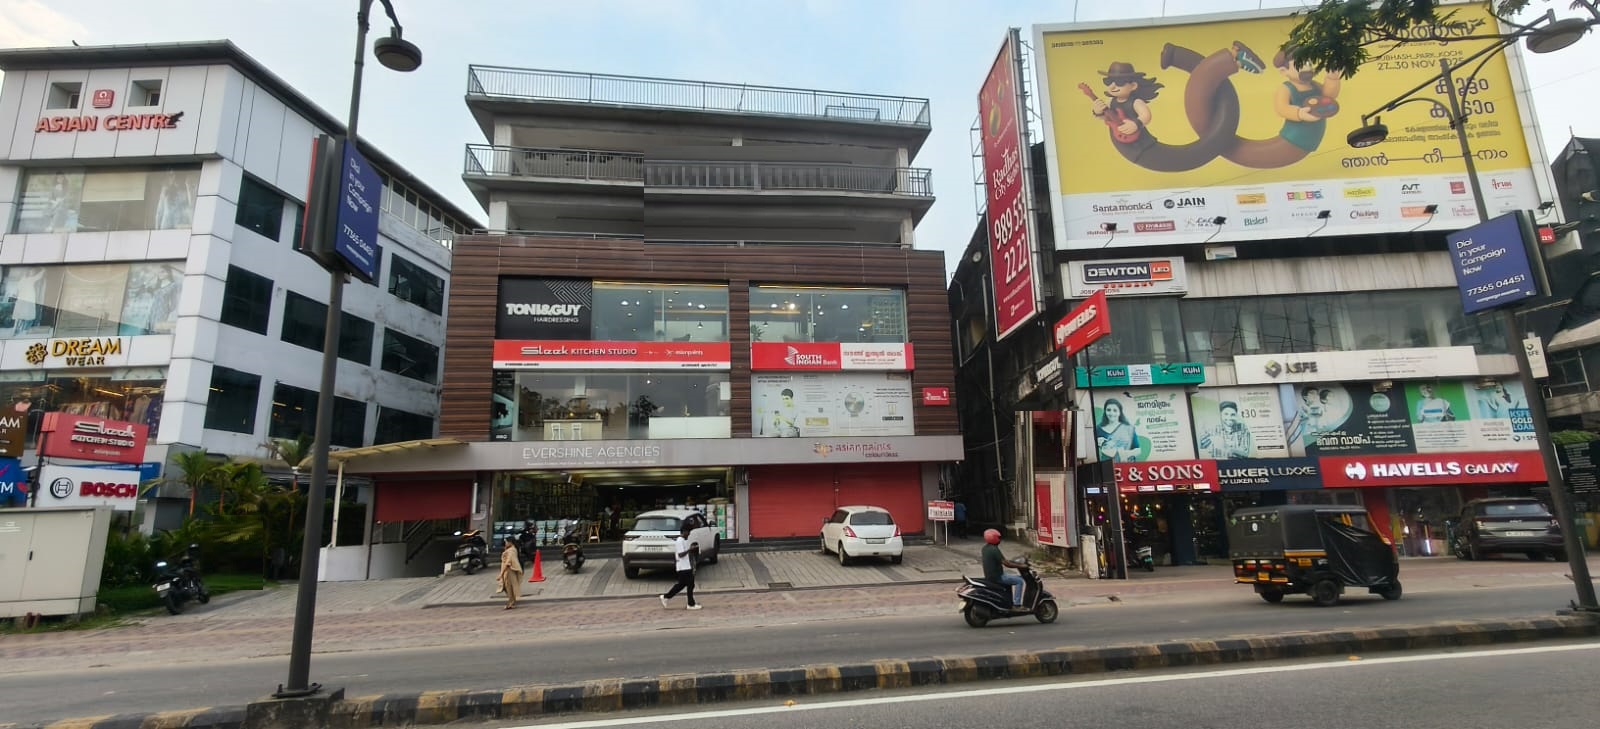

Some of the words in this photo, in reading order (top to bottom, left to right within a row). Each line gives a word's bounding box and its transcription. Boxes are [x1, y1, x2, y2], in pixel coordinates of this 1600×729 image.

[1411, 60, 1436, 69] NOV
[35, 116, 98, 133] ASIAN
[1177, 197, 1205, 207] JAIN
[994, 207, 1013, 250] 989
[1456, 237, 1473, 249] Dial
[1459, 250, 1467, 258] in
[1466, 244, 1486, 256] your
[1461, 247, 1506, 266] Campaign
[1087, 266, 1148, 277] DEWTON
[1462, 265, 1482, 275] Now
[1467, 283, 1494, 296] 77365
[1496, 274, 1525, 288] 04451
[506, 303, 582, 316] TONI&GUY
[52, 338, 121, 357] DREAM
[66, 356, 105, 366] WEAR
[522, 447, 593, 459] EVERSHINE
[597, 446, 660, 458] AGENCIES
[1128, 466, 1143, 482] &
[1148, 463, 1204, 480] SONS
[1218, 467, 1269, 478] LUKER
[1270, 465, 1317, 477] LUXXE
[1372, 462, 1461, 477] HAVELLS
[1464, 462, 1520, 475] GALAXY
[1230, 477, 1253, 485] LUKER
[80, 481, 138, 497] BOSCH
